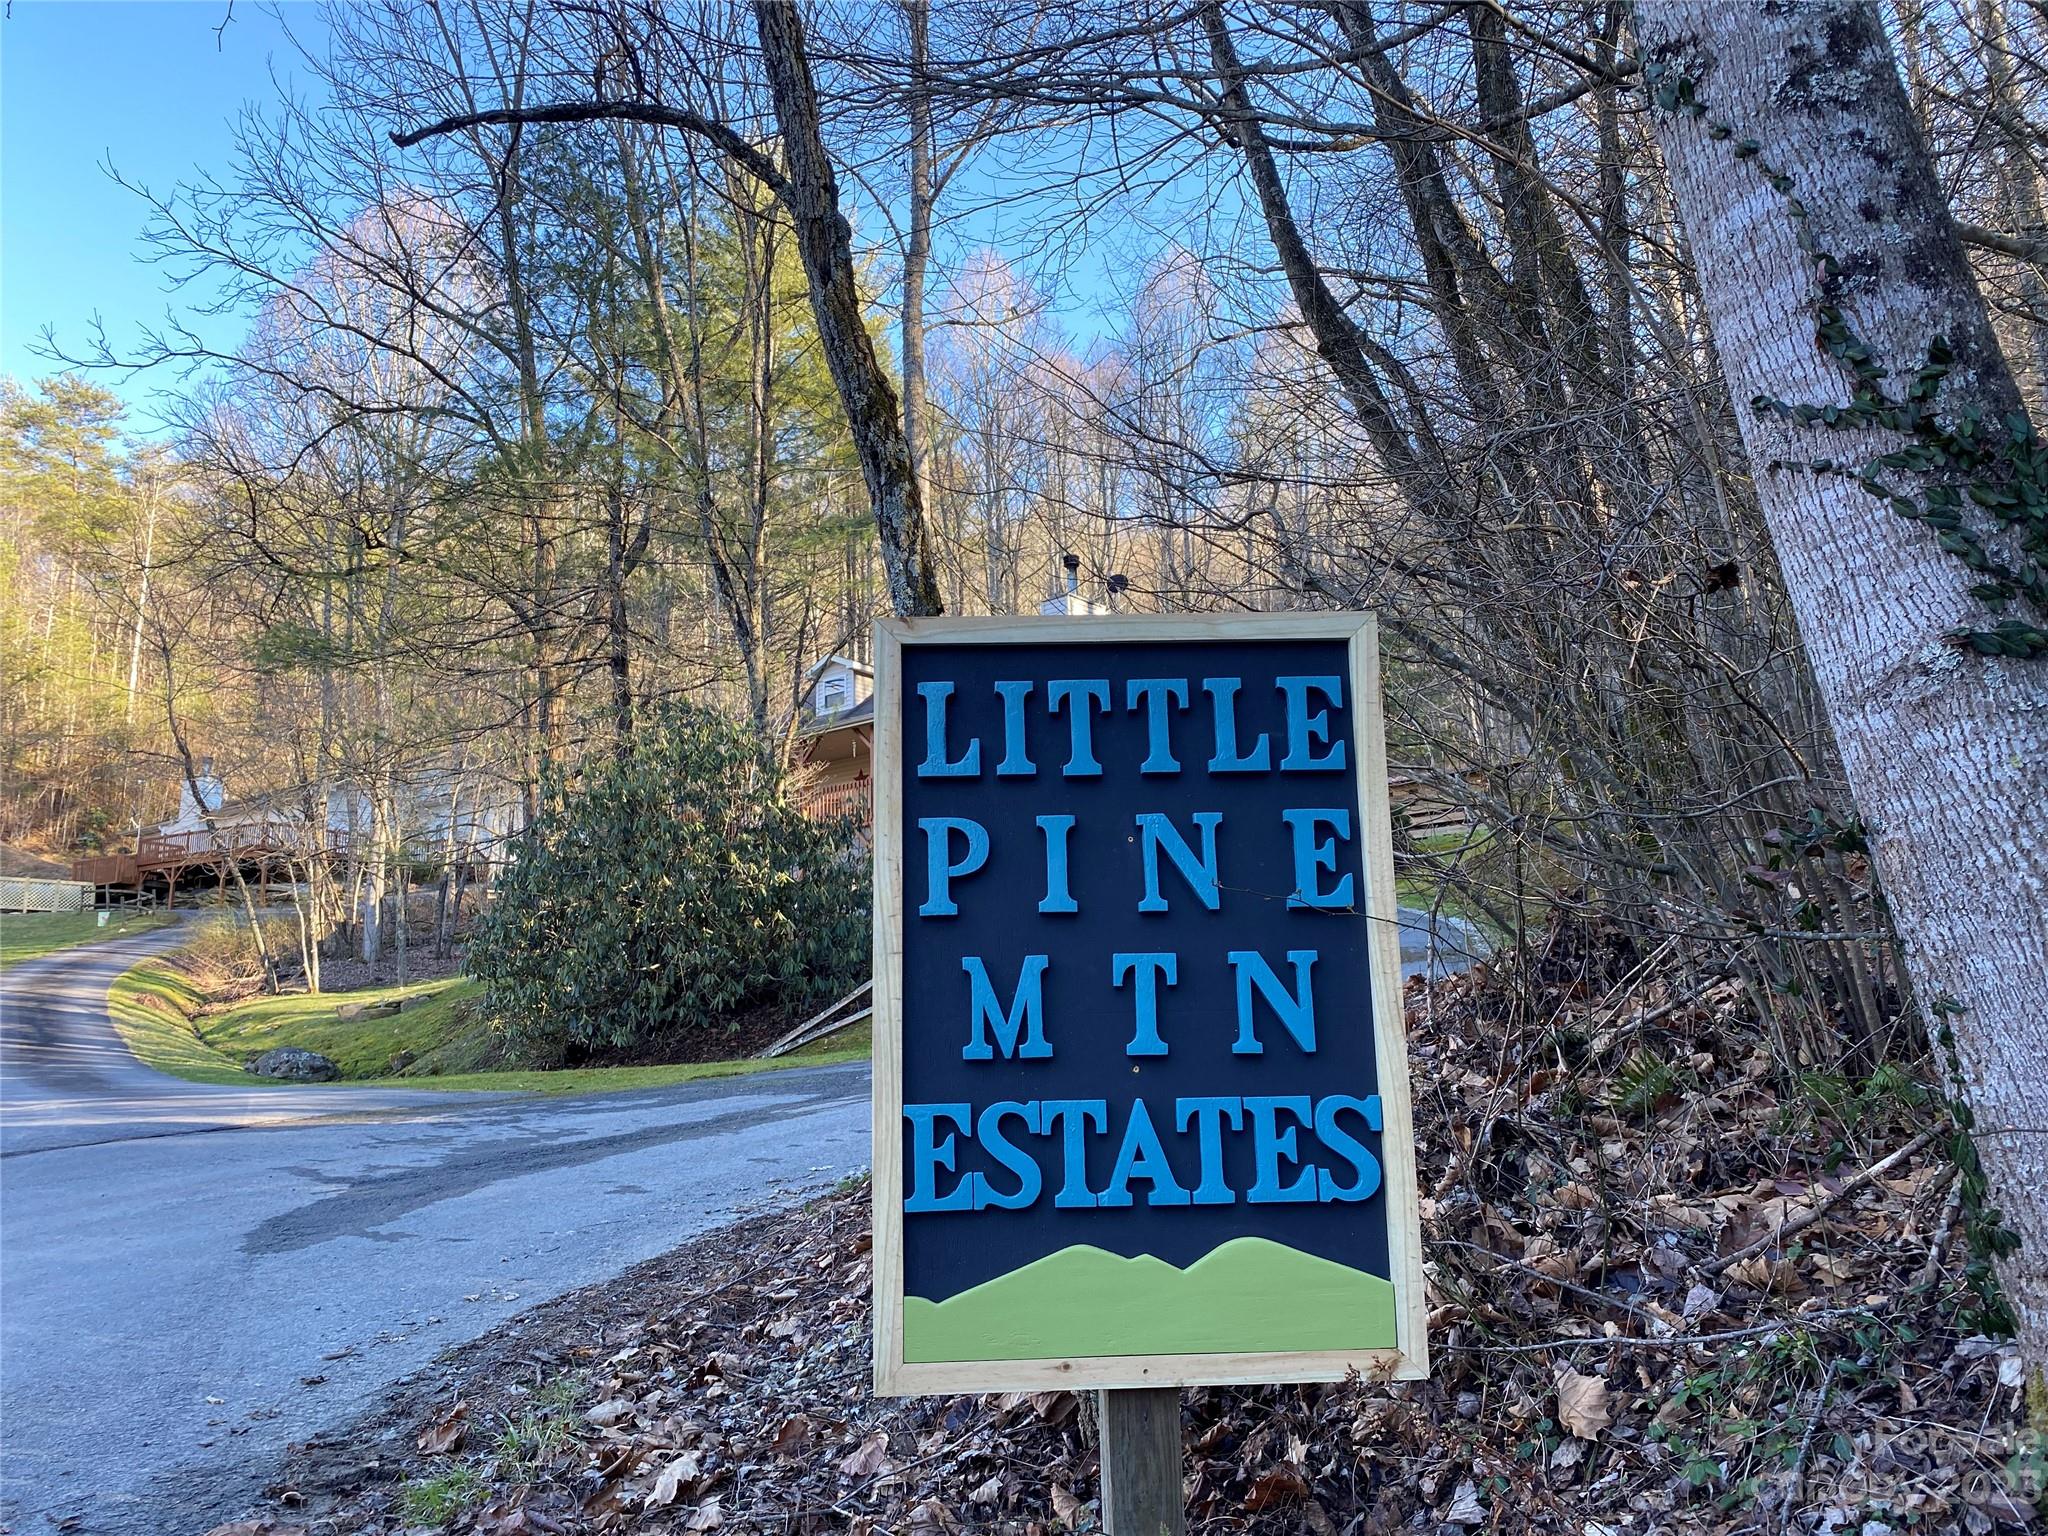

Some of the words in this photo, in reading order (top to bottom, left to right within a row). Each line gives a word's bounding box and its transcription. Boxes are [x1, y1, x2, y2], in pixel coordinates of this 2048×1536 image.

[917, 676, 1346, 776] LITTLE
[918, 808, 1355, 916] PINE
[961, 950, 1318, 1060] MTN
[903, 1094, 1383, 1212] ESTATES
